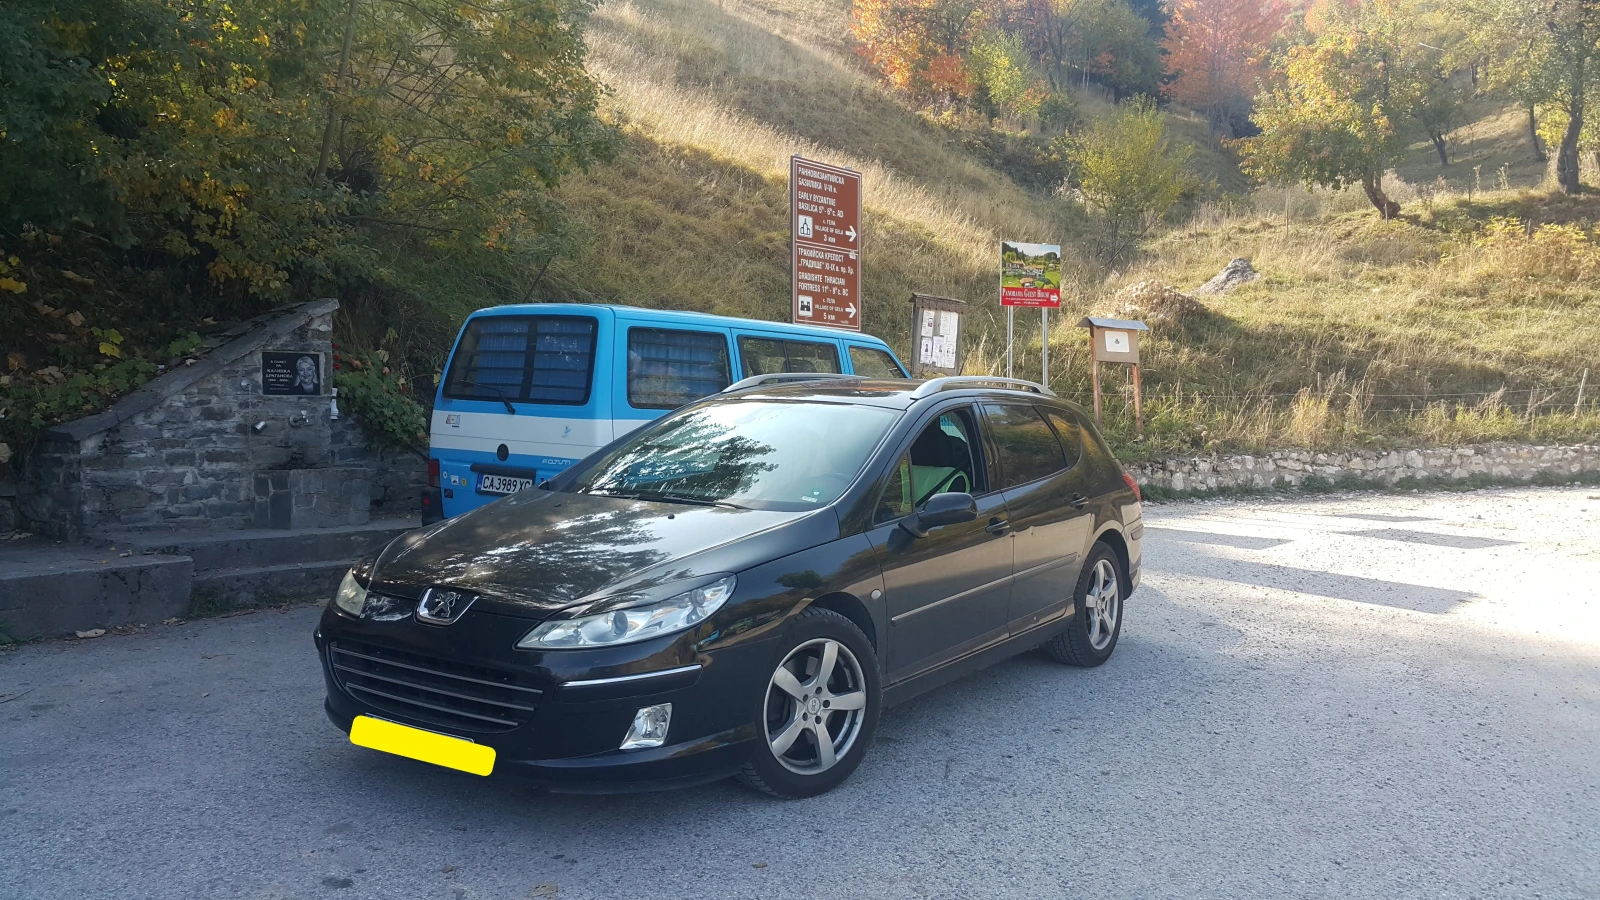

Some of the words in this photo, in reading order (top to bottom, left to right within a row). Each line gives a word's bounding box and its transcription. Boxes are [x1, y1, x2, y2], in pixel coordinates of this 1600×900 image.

[798, 167, 844, 185] РАННОВИЗАНТИЙСКА
[798, 178, 822, 190] БАЗИЛИКА
[798, 191, 812, 200] EARLY
[813, 193, 836, 206] BYZANTINE
[798, 202, 818, 212] BASILICA
[798, 248, 824, 259] ТРАКИЙСКА
[825, 252, 844, 262] КРЕПОСТ
[798, 272, 822, 282] GRADISHTE
[824, 275, 845, 286] THRACIAN
[799, 282, 820, 292] FORTRESS
[483, 476, 494, 490] CA
[496, 478, 517, 492] 3989
